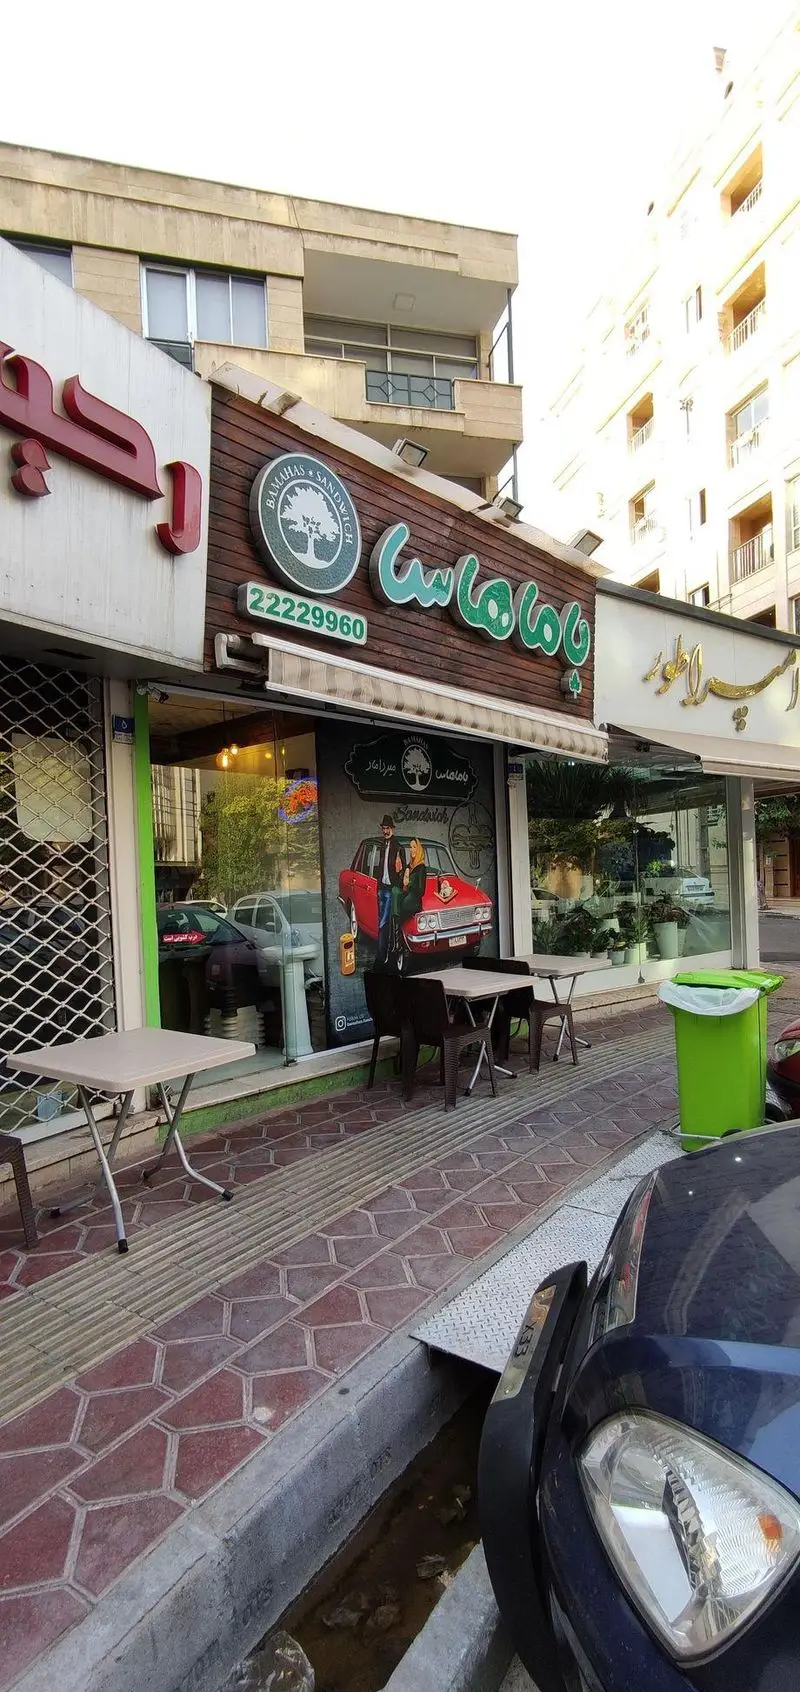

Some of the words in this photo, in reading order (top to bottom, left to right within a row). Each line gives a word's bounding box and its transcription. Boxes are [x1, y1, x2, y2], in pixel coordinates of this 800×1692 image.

[265, 464, 306, 510] BAMAHAS
[315, 470, 354, 545] SANDWICH
[249, 586, 365, 641] 22229960
